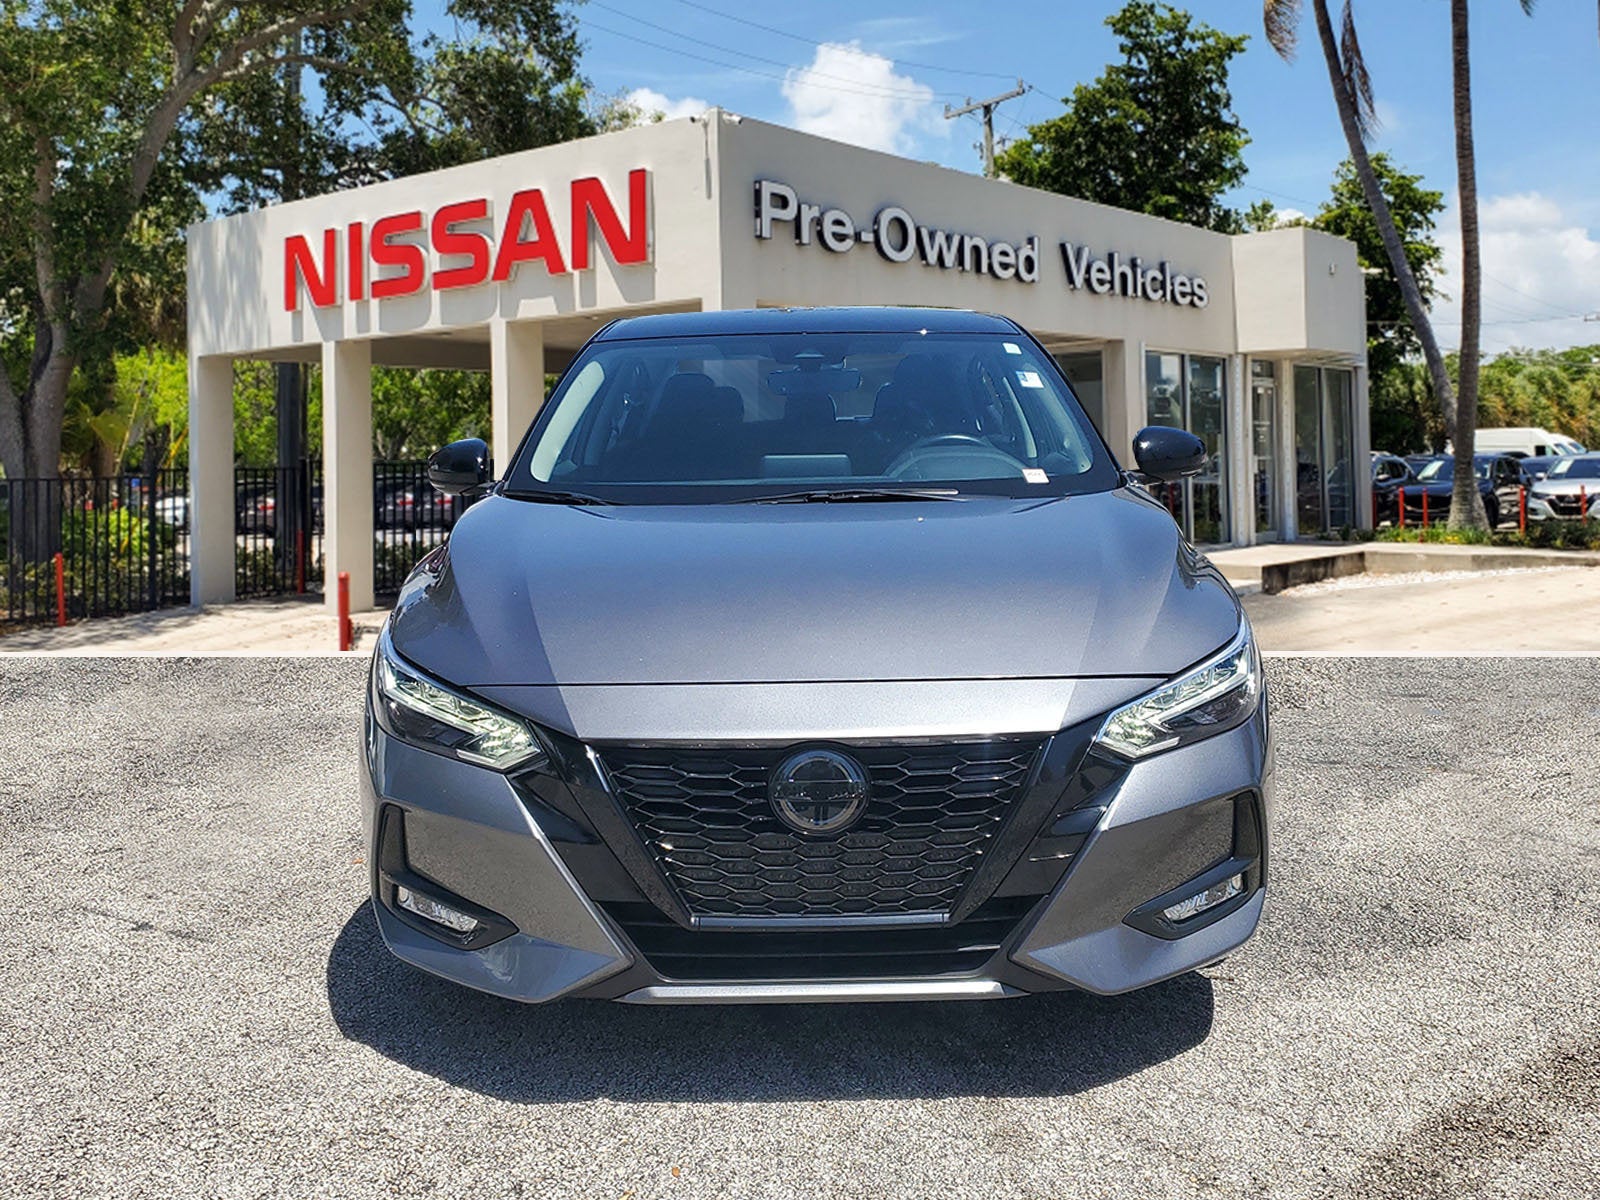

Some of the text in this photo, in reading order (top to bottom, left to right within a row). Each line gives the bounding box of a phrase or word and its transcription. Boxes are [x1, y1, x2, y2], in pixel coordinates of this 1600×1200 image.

[285, 169, 648, 311] NISSAN
[754, 180, 1210, 309] Pre-Owned Vehicles
